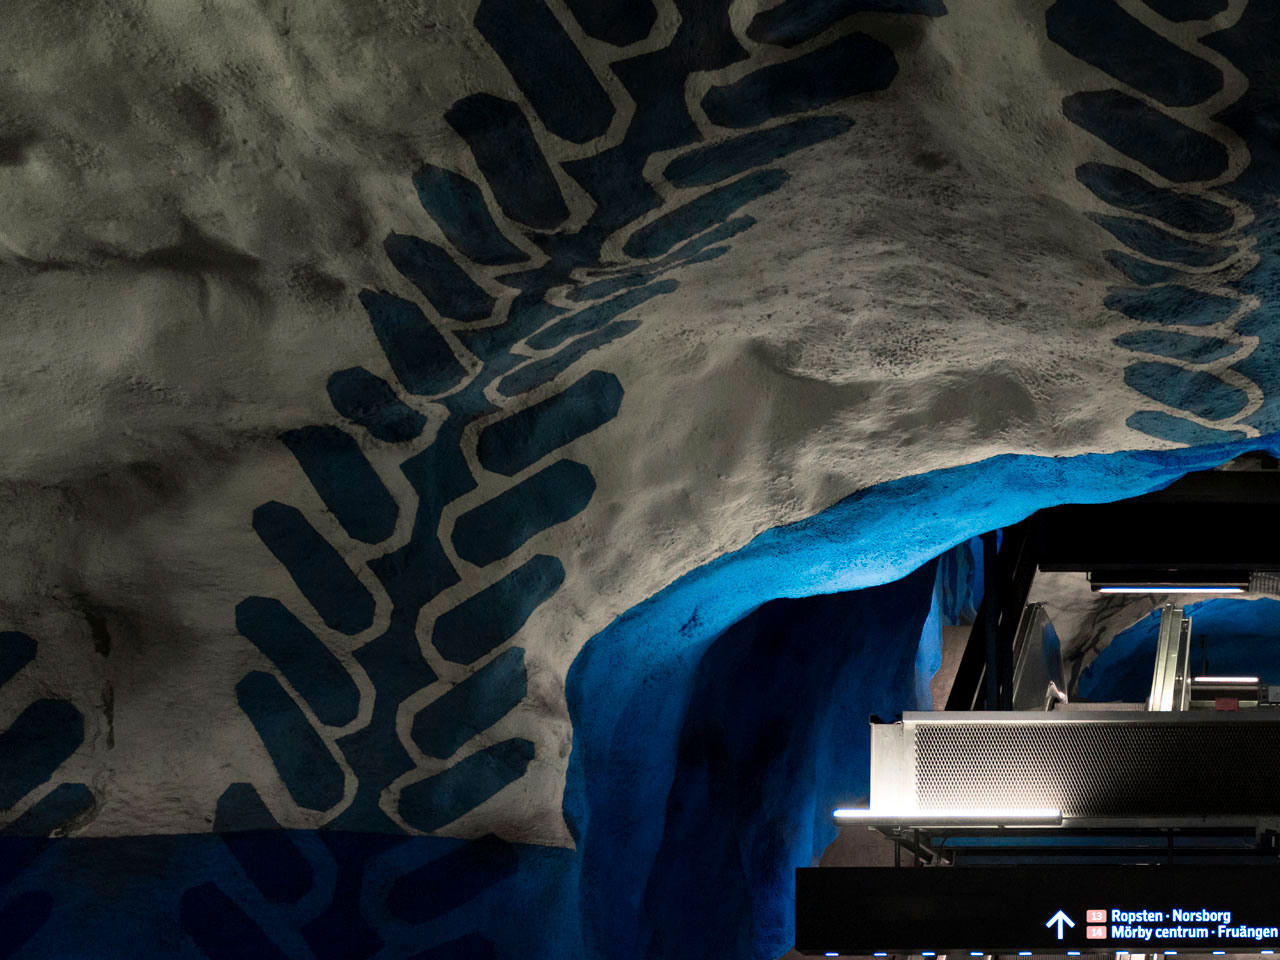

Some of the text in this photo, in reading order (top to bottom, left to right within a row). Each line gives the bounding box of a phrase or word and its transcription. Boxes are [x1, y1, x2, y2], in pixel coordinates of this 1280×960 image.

[1091, 909, 1231, 924] 13 Ropsten Norsborg
[1091, 925, 1279, 941] 14 Mörby centrum Fruängen
